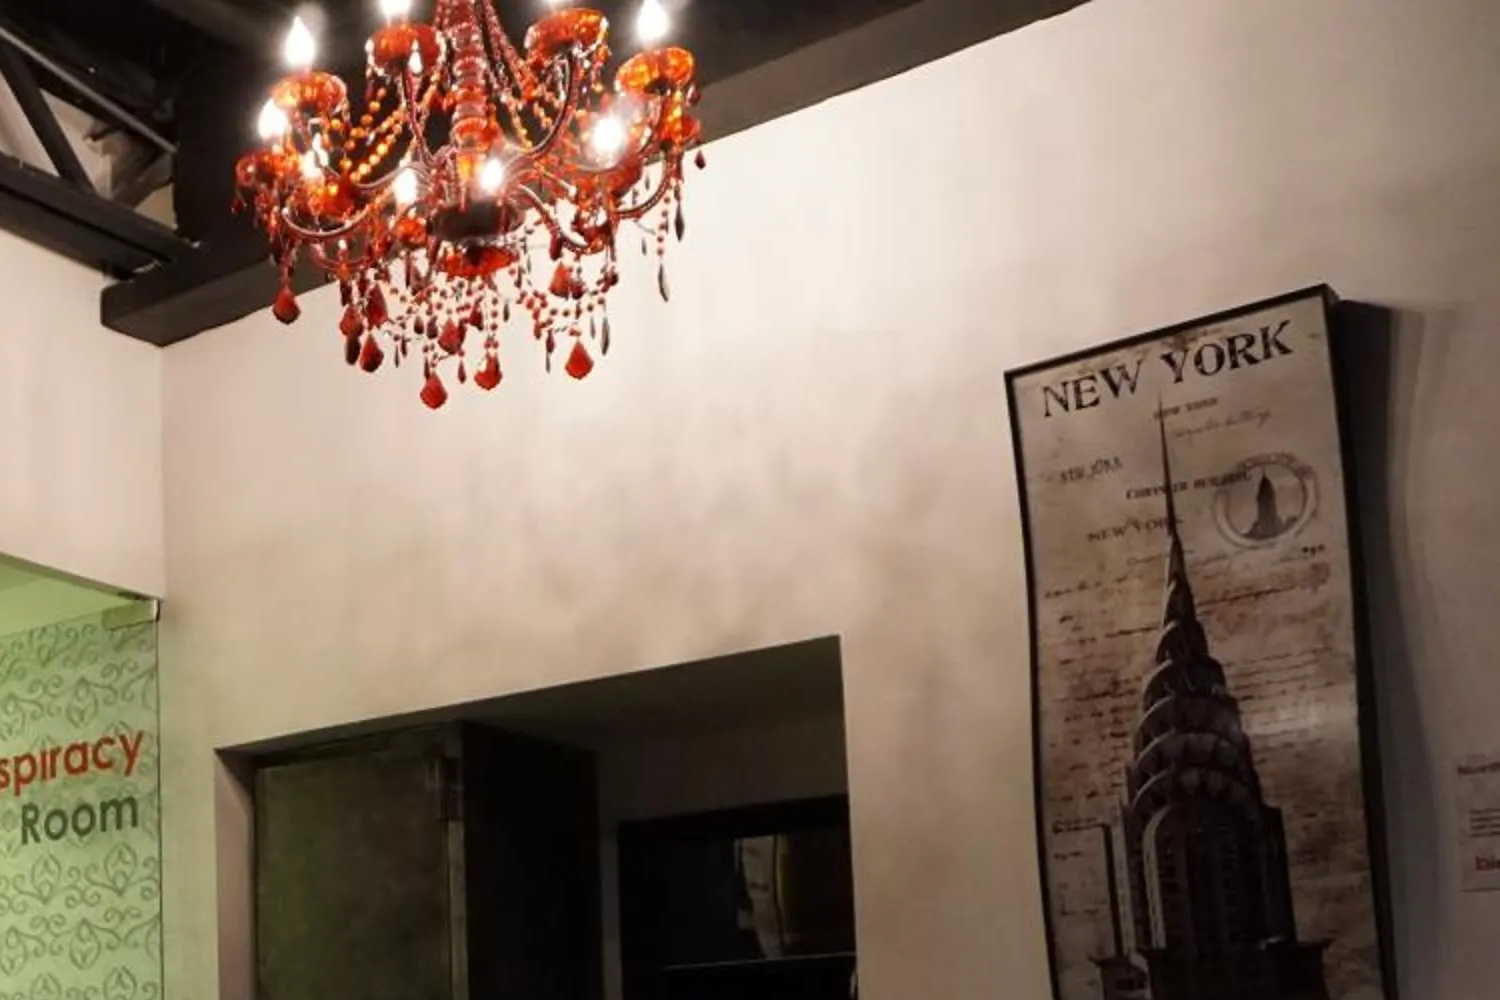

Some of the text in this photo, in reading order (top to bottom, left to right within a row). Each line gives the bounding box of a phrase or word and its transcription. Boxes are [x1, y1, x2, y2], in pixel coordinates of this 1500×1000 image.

[1042, 319, 1294, 418] NEW YORK
[21, 796, 139, 845] Room
